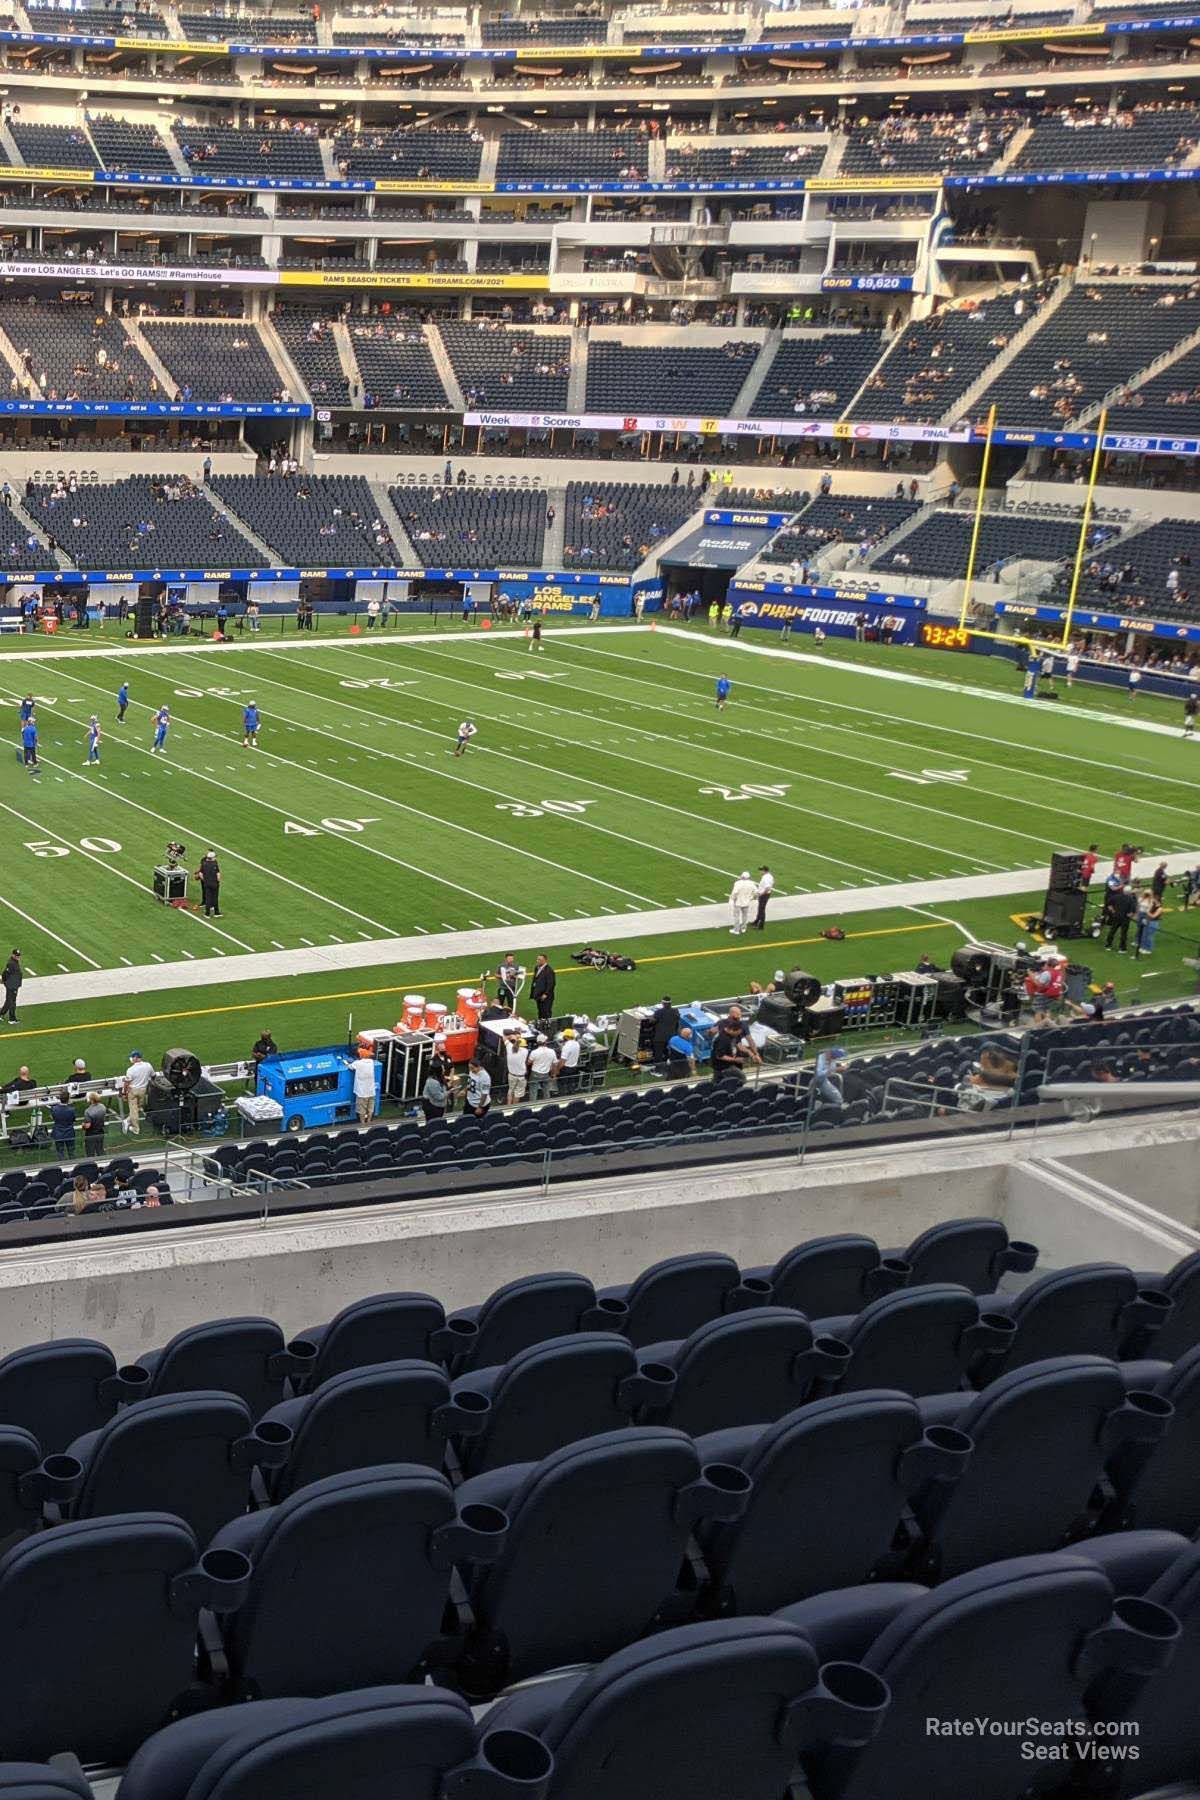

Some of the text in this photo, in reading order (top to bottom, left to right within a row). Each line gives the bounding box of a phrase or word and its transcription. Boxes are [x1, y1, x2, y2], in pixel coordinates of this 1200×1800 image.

[57, 268, 98, 276] ANGELES.
[101, 269, 120, 277] Let's
[170, 272, 222, 280] #RamsHouse
[324, 276, 345, 284] RAMS
[858, 278, 900, 289] $9,620
[480, 415, 510, 425] Week
[542, 416, 581, 426] Scores
[705, 422, 715, 430] 17
[737, 423, 762, 432] FINAL
[837, 426, 848, 434] 41
[922, 429, 949, 438] FINAL
[1005, 434, 1035, 442] RAMS
[733, 515, 769, 524] RAMS
[7, 574, 35, 582] RAMS
[600, 576, 630, 584] RAMS
[534, 587, 561, 595] LOS
[735, 582, 765, 591] RAMS
[533, 594, 597, 603] ANGELES
[835, 591, 867, 601] RAMS
[532, 603, 573, 611] RAMS
[1005, 605, 1037, 615] RAMS
[1120, 620, 1155, 631] RAMS
[922, 626, 968, 646] 73:29
